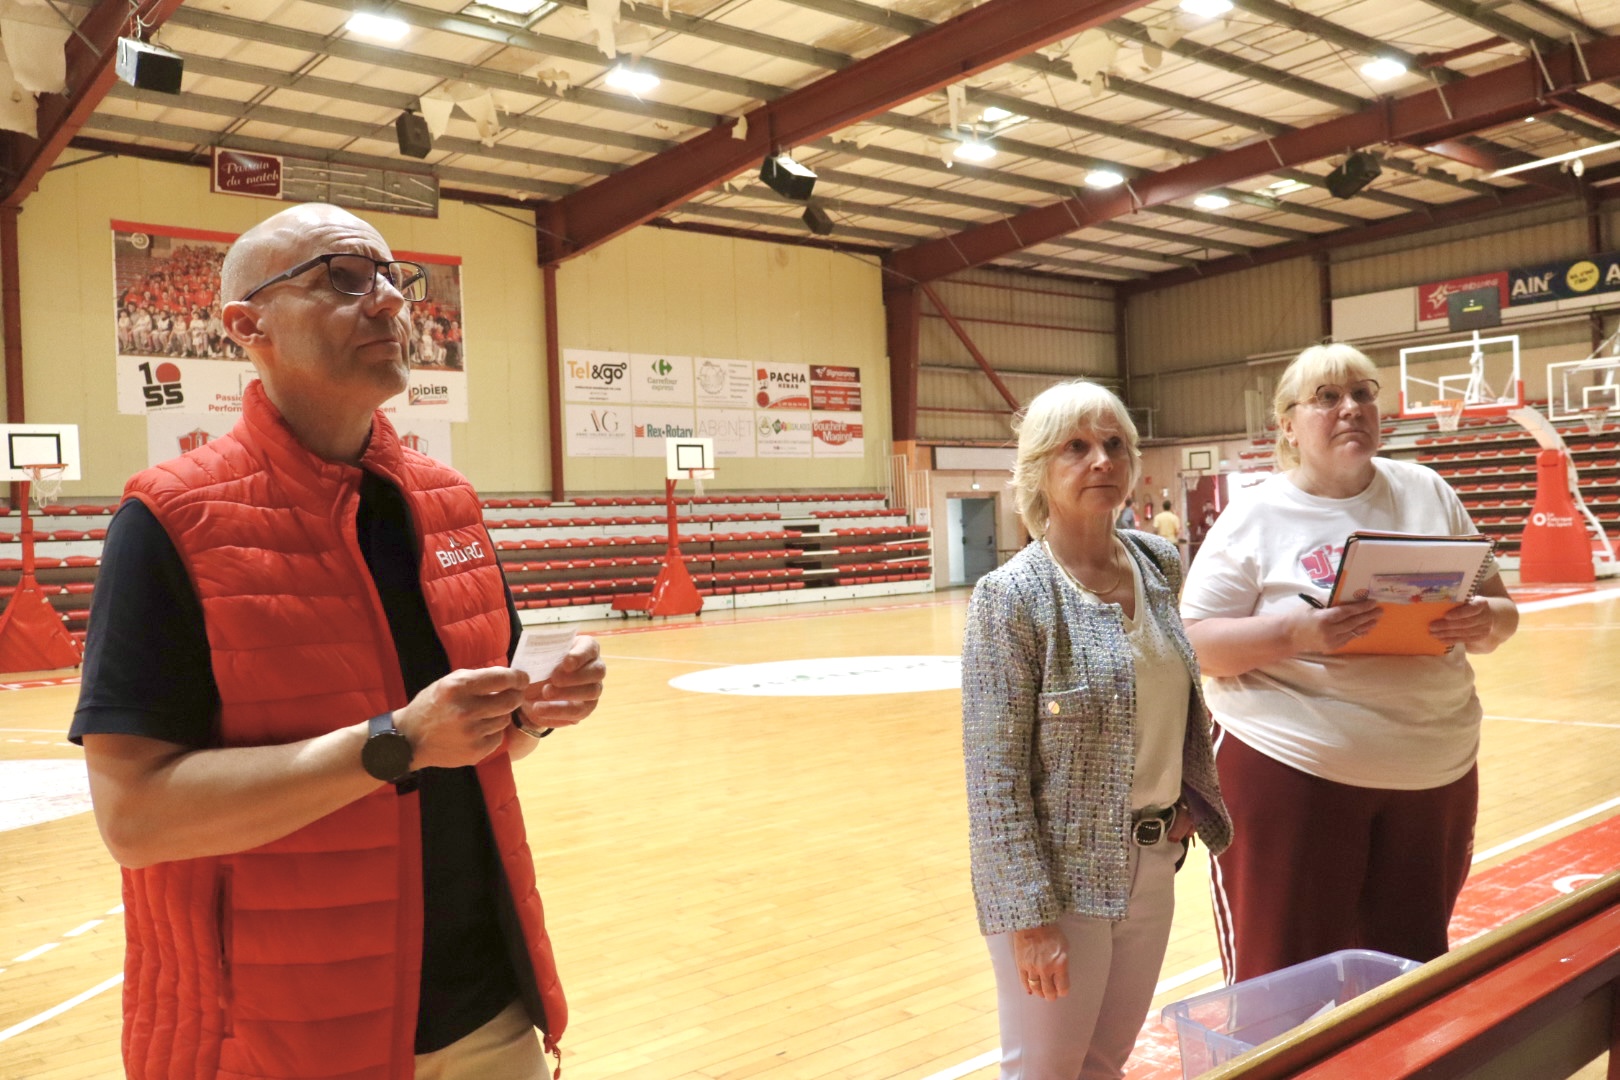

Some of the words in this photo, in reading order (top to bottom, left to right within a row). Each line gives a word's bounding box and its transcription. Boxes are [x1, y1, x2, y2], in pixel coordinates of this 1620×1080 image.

[226, 175, 241, 187] du
[246, 171, 279, 185] match
[1511, 276, 1549, 296] AIN
[567, 361, 627, 385] Tel&go
[647, 377, 677, 385] Carrefour
[769, 372, 806, 383] PACHA
[142, 383, 184, 407] 55
[435, 541, 485, 569] BOURG
